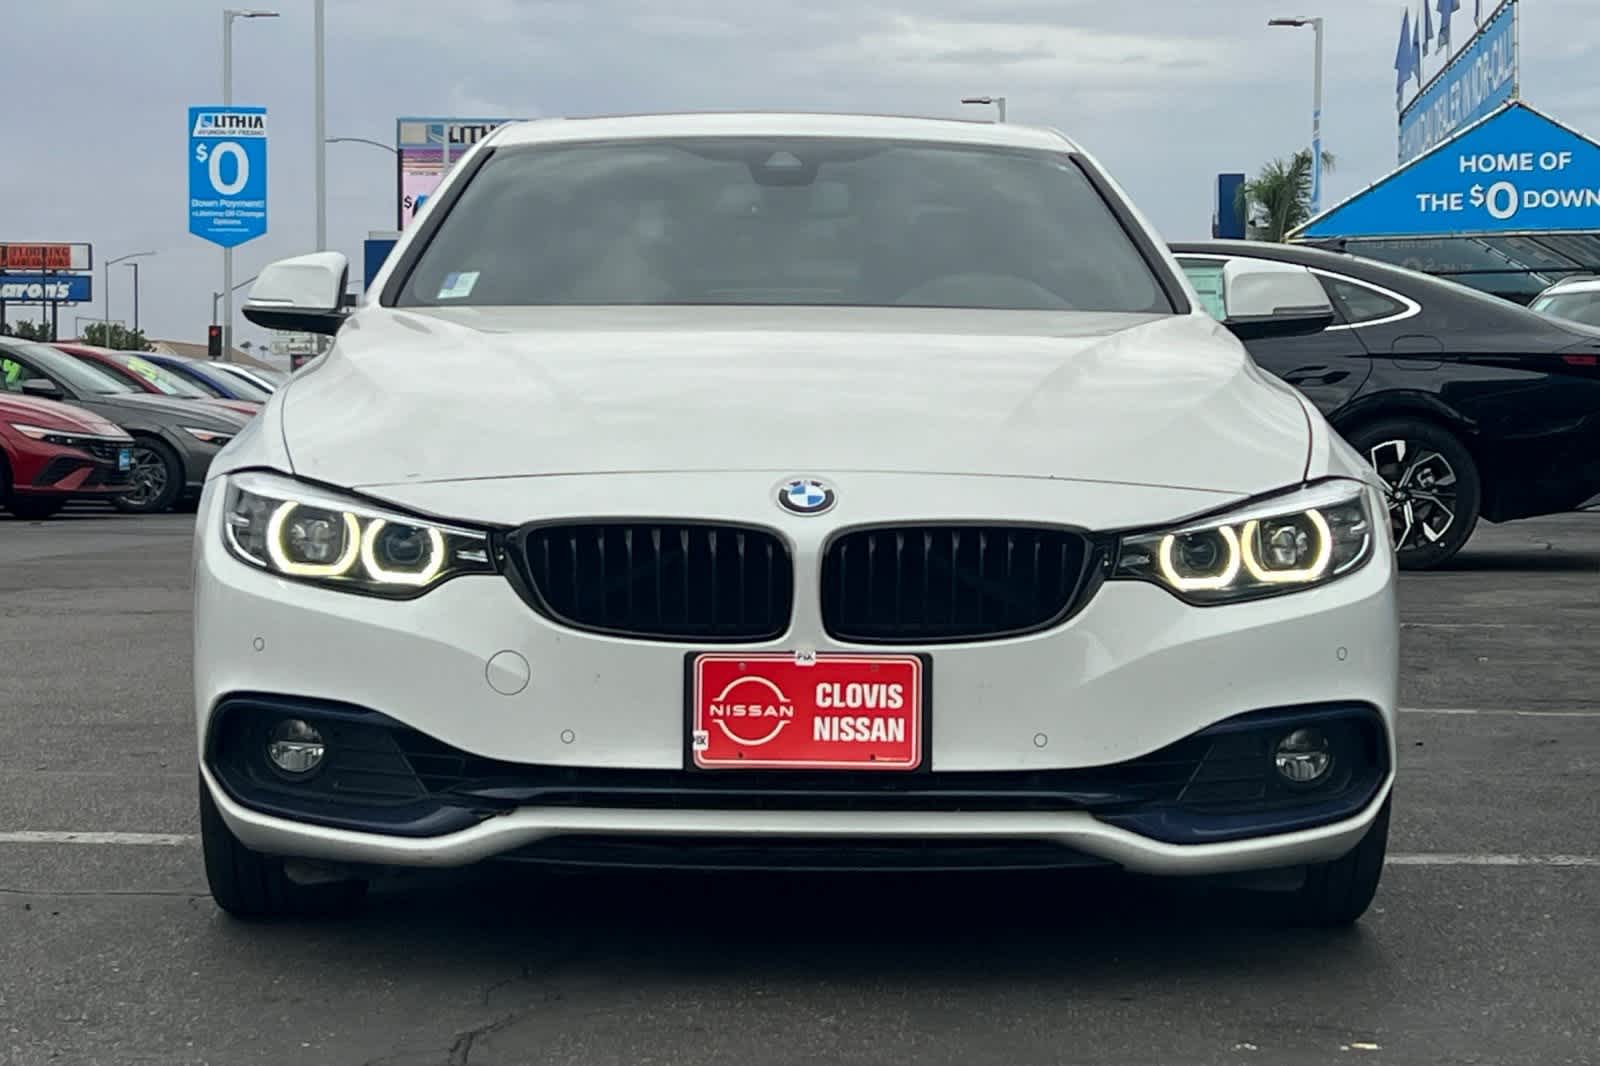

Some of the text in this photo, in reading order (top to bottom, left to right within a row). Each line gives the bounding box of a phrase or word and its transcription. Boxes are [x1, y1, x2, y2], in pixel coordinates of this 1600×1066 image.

[214, 115, 264, 129] LITHIA
[196, 141, 249, 195] $0
[1459, 151, 1572, 173] HOME OF
[219, 199, 265, 209] Payment
[1416, 181, 1600, 219] THE $0 DOWN
[0, 281, 70, 298] aron's
[815, 682, 904, 709] CLOVIS
[709, 704, 794, 717] NISSAN
[813, 716, 905, 743] NISSAN
